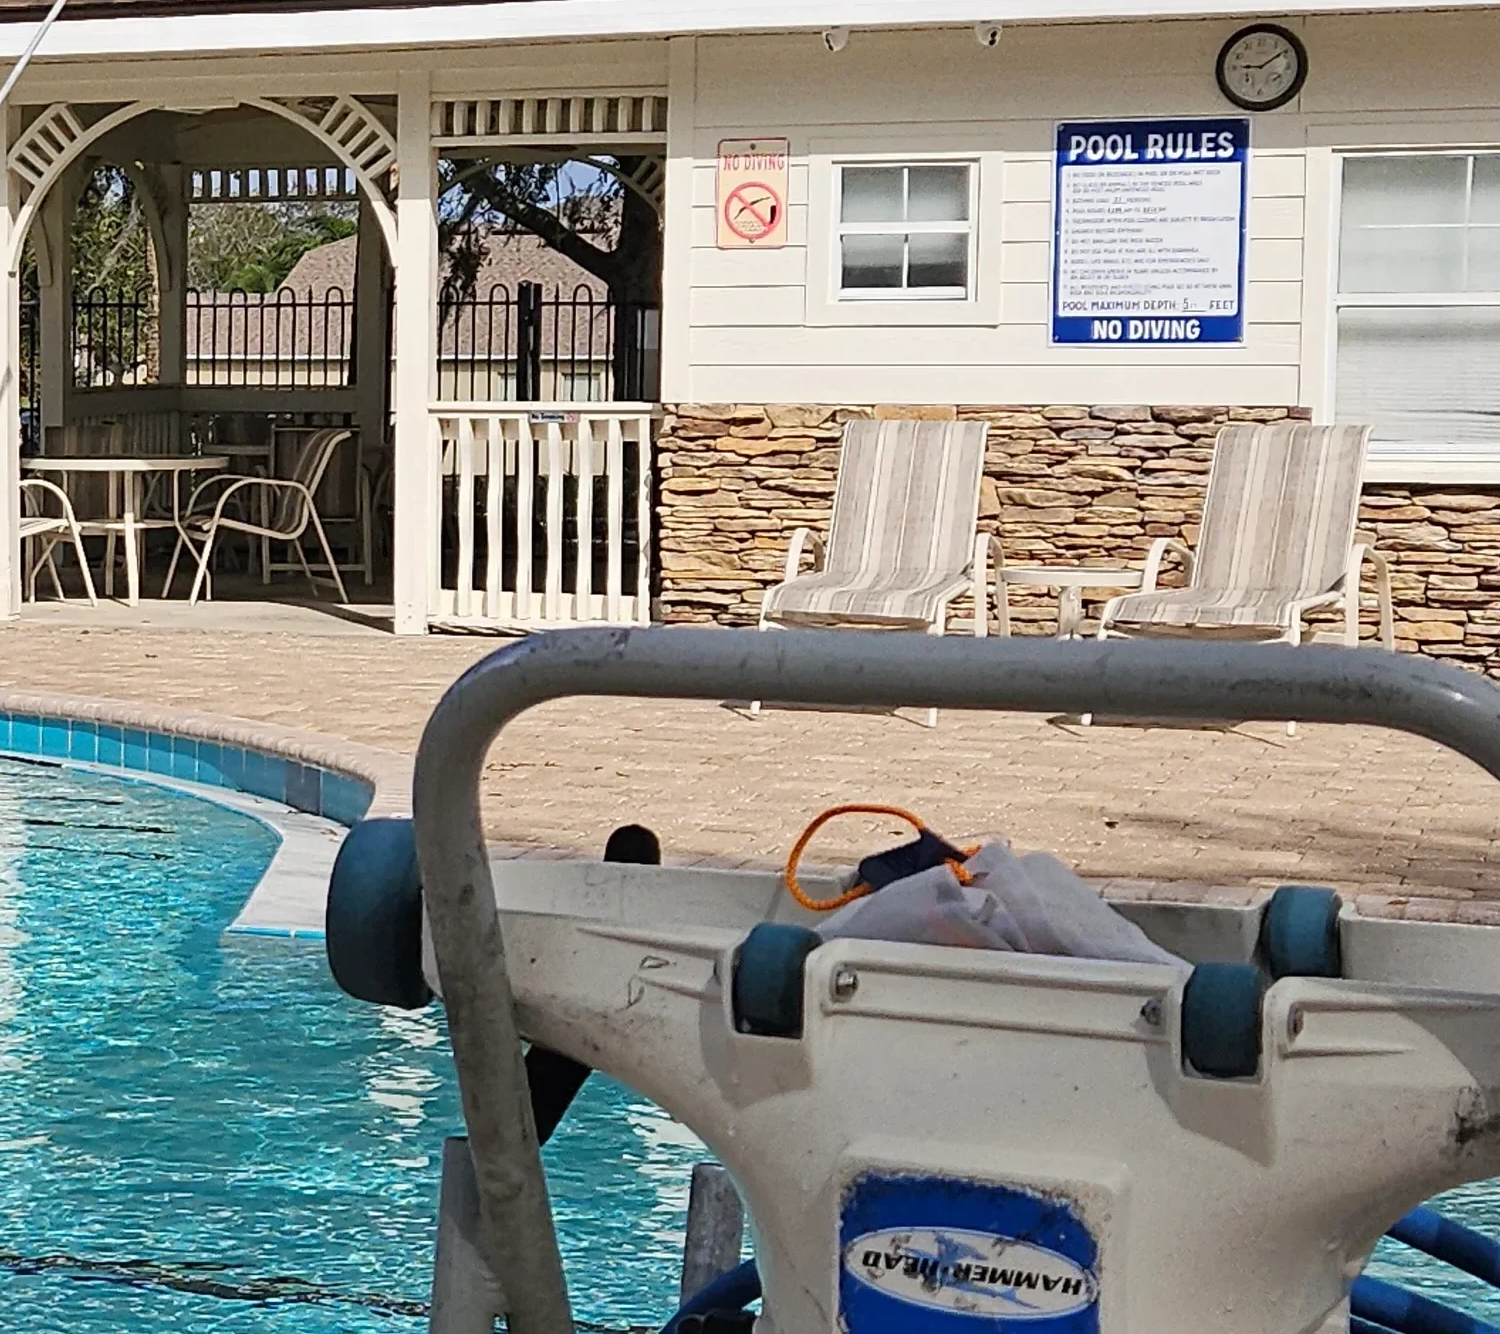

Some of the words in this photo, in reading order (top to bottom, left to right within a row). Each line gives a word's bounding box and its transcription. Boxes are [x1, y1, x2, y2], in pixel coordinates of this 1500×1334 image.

[1069, 134, 1138, 162] POOL
[1146, 131, 1235, 160] RULES
[723, 153, 740, 171] NO
[744, 152, 785, 171] DIVING
[1062, 300, 1088, 311] POOL
[1091, 300, 1141, 311] MAXIMUM
[1208, 299, 1235, 310] FEET
[1093, 319, 1123, 340] NO
[1128, 319, 1201, 340] DIVING
